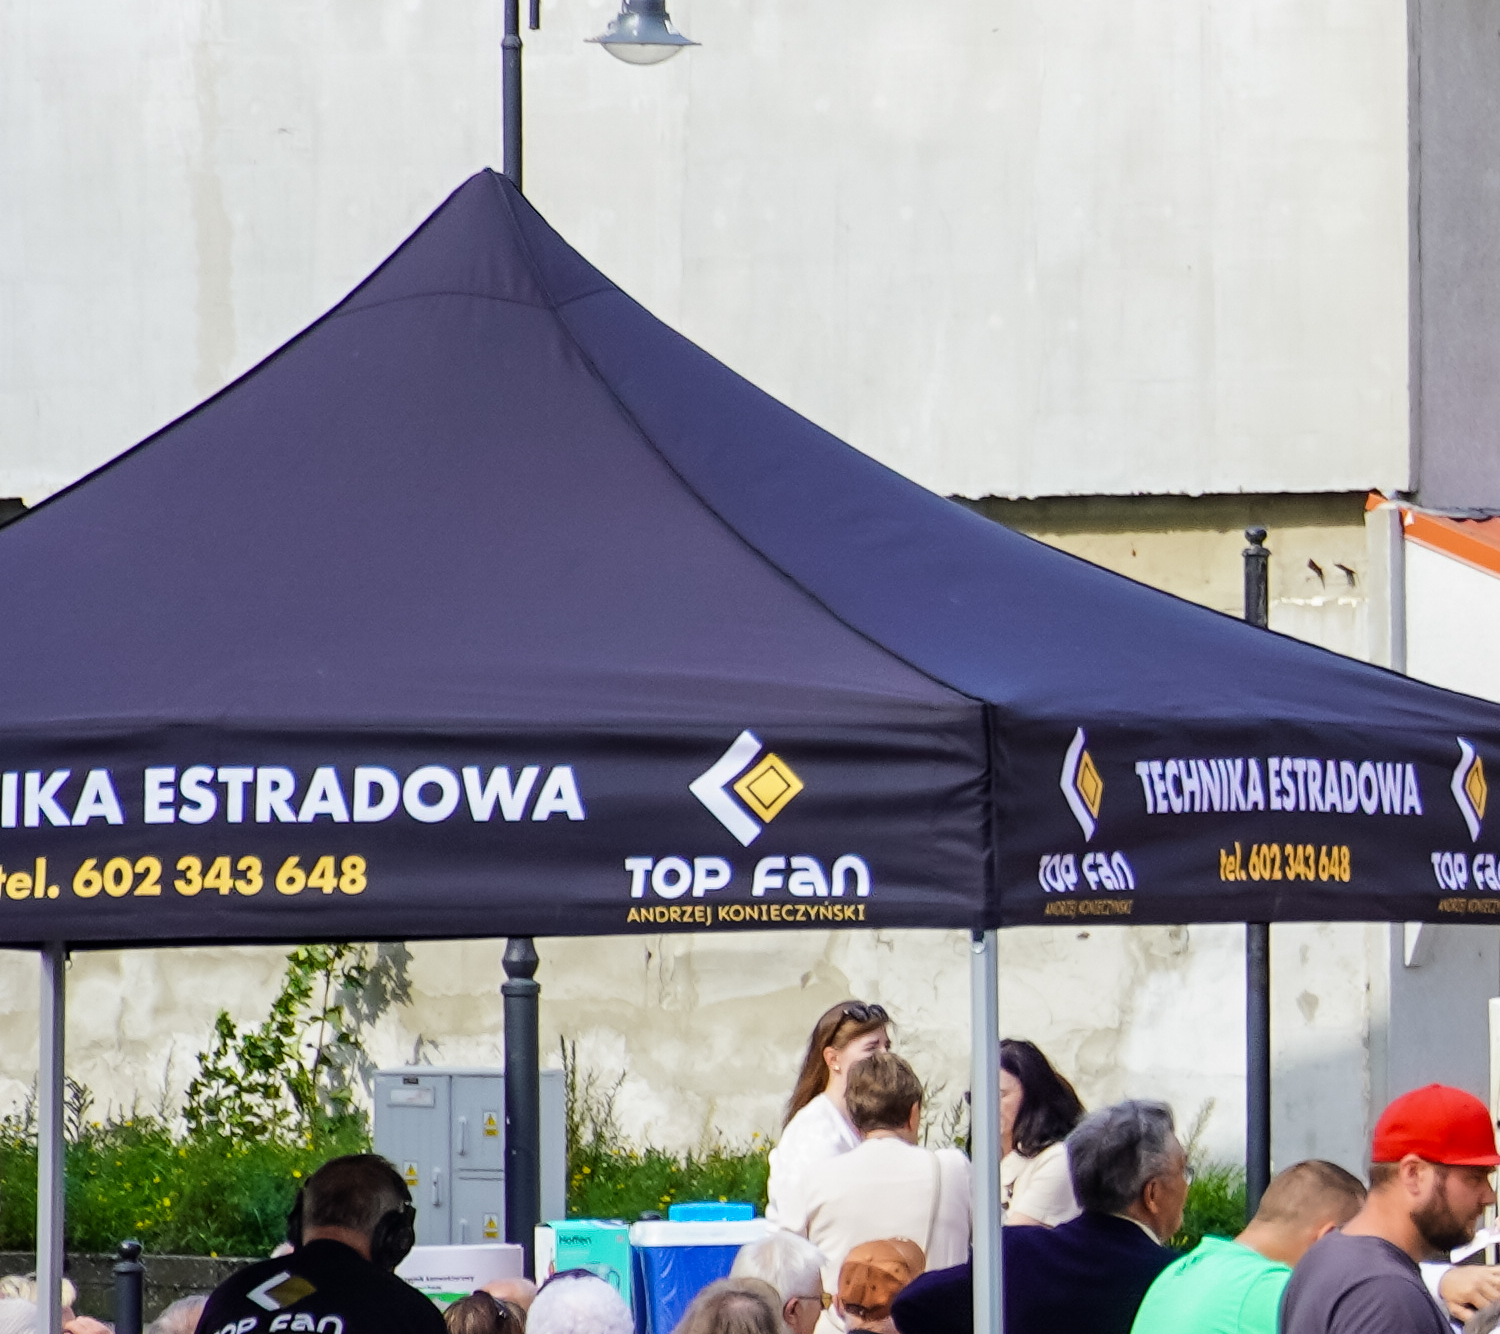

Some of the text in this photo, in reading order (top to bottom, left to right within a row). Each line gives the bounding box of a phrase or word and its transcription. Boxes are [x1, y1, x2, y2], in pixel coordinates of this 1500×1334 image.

[144, 765, 586, 824] ESTRADOWA
[1135, 756, 1423, 815] TECHNIKA ESTRADOWA
[72, 857, 162, 898] 602
[174, 856, 264, 896] 343
[275, 855, 368, 895] 648
[625, 856, 733, 900] TOP
[1038, 853, 1082, 893] TOP
[1219, 841, 1351, 883] tel. 602 343 648
[1430, 852, 1469, 891] TOP
[627, 900, 865, 926] ANDRZEJ KONIECZYŃSKI
